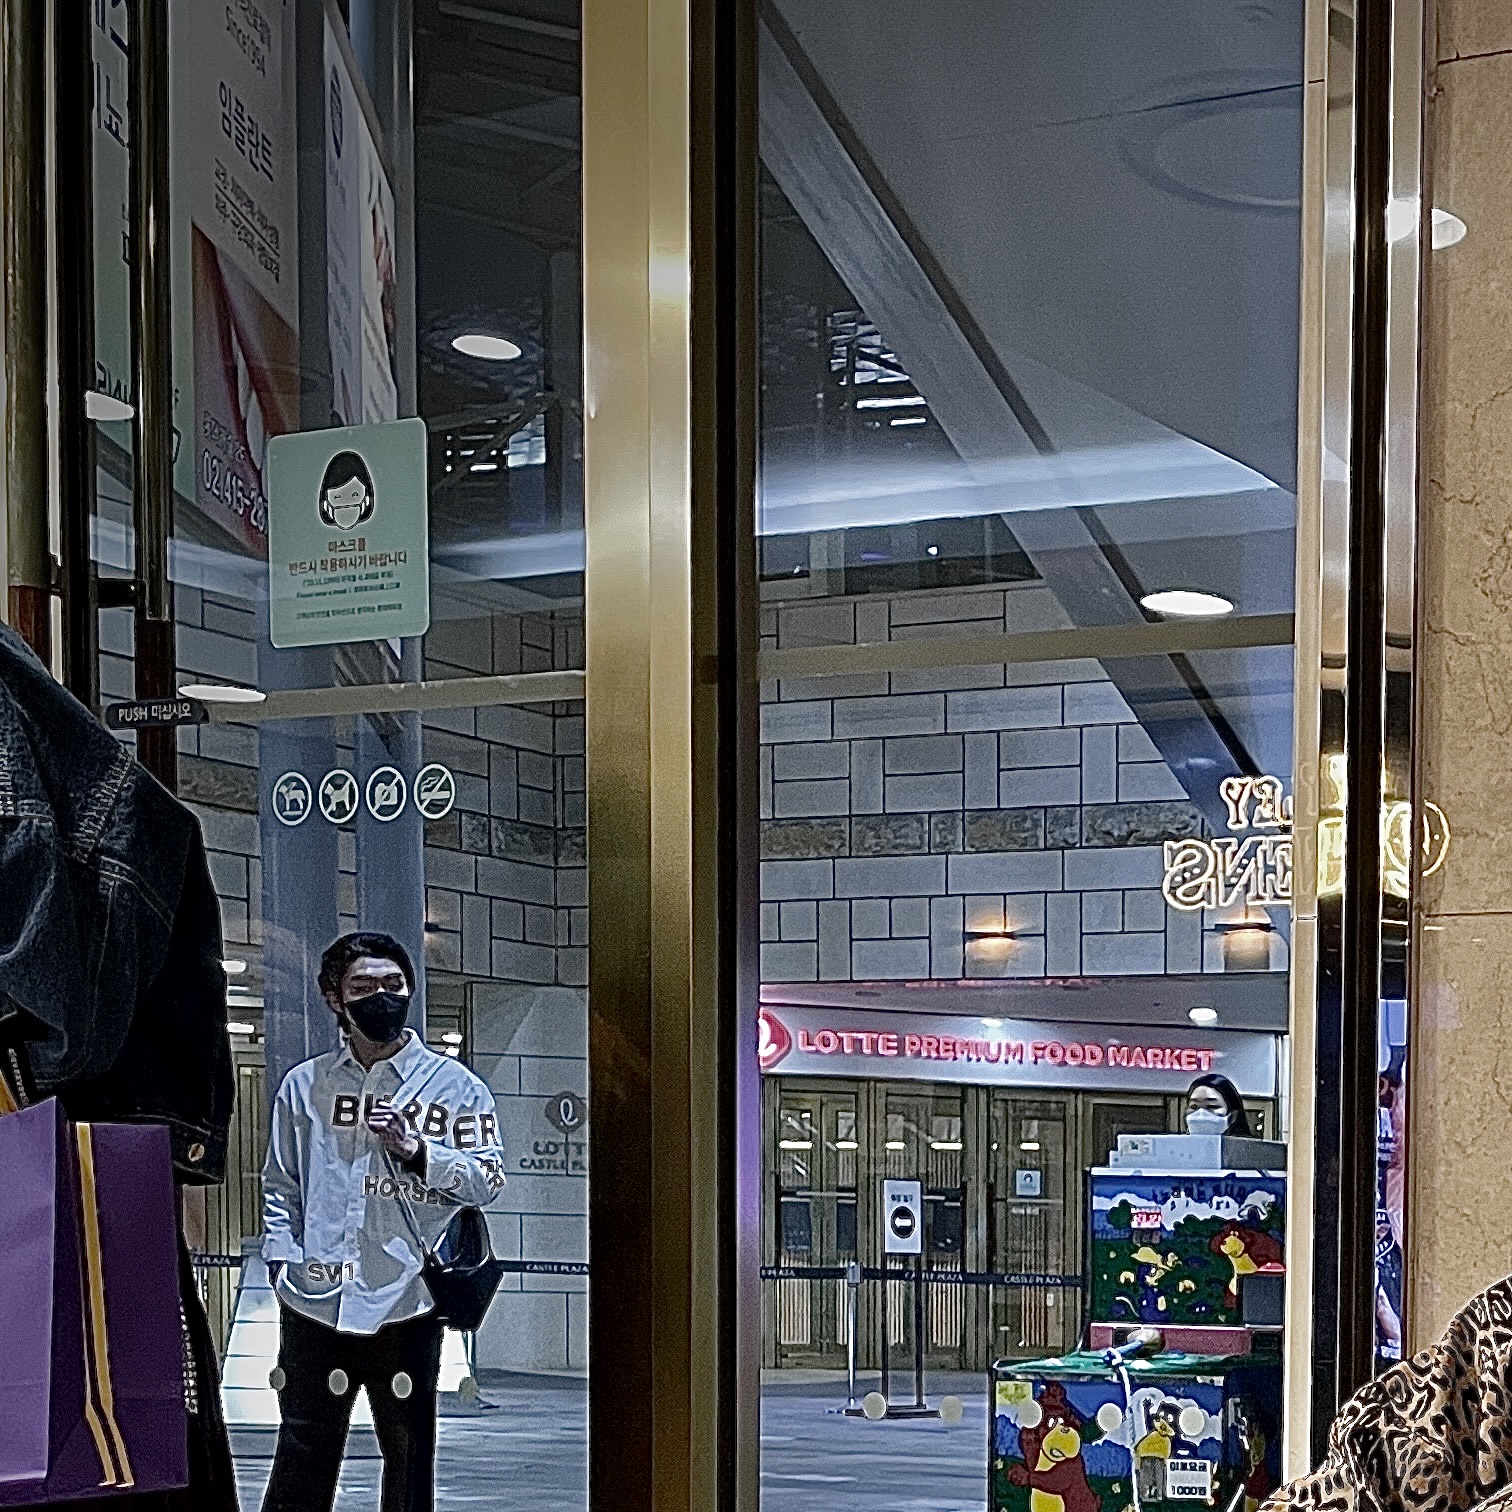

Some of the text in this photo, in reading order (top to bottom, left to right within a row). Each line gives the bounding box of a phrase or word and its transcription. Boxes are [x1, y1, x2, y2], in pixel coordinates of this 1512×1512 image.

[288, 559, 317, 576] 반드시
[118, 706, 148, 722] PUSH
[797, 1029, 1216, 1072] LOTTE PREMIUM FOOD MARKET
